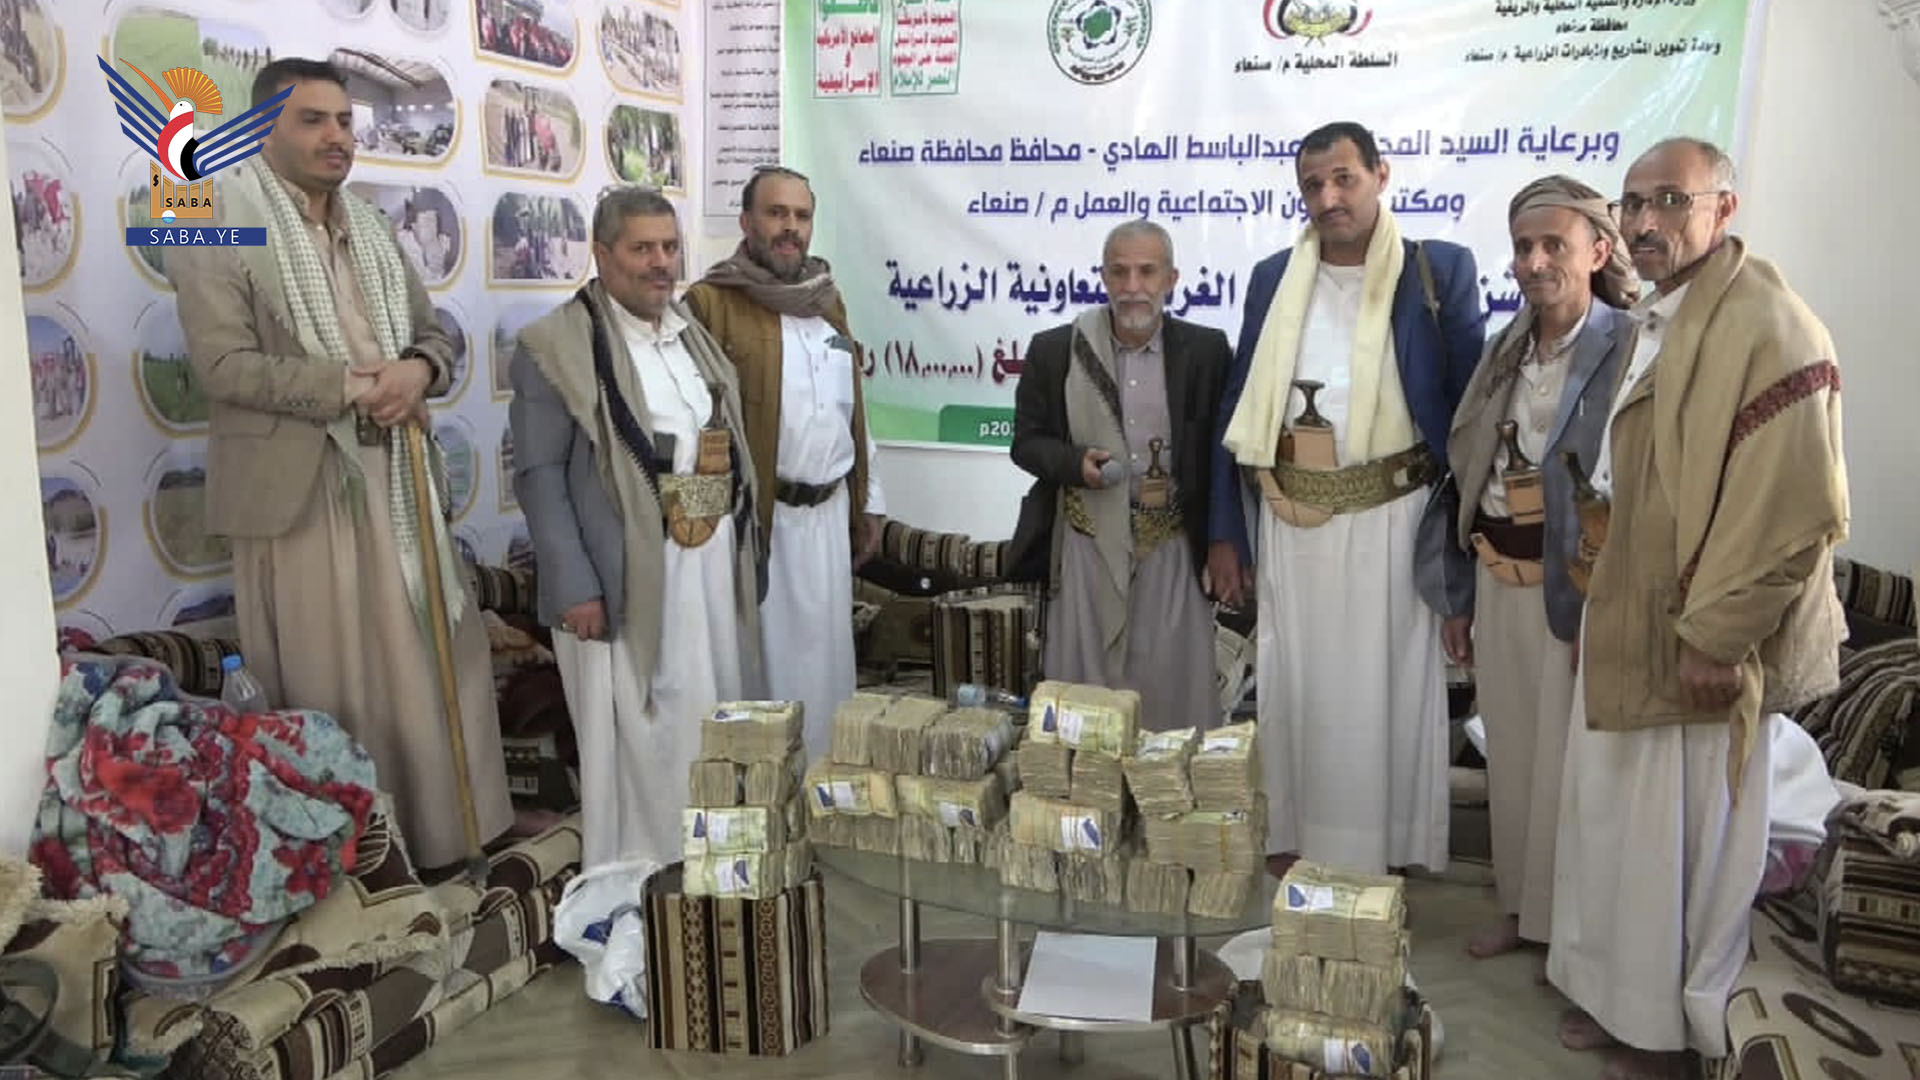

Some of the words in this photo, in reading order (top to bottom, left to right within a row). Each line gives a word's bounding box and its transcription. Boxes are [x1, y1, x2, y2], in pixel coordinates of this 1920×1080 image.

[1234, 56, 1272, 73] صنعاء
[1295, 53, 1345, 75] المحلية
[1349, 49, 1398, 68] السلطة
[858, 139, 915, 164] صنعاء
[921, 138, 1003, 163] محافظة
[1010, 137, 1081, 162] محافظ
[1103, 135, 1178, 172] الهادي
[1440, 128, 1509, 162] السيد
[1517, 125, 1620, 162] وبرعاية
[967, 191, 1029, 214] صنعاء
[1074, 189, 1150, 221] والعمل
[1157, 189, 1273, 222] الاجتماعية
[885, 260, 998, 311] الزراعية
[1006, 260, 1109, 315] تعاونية
